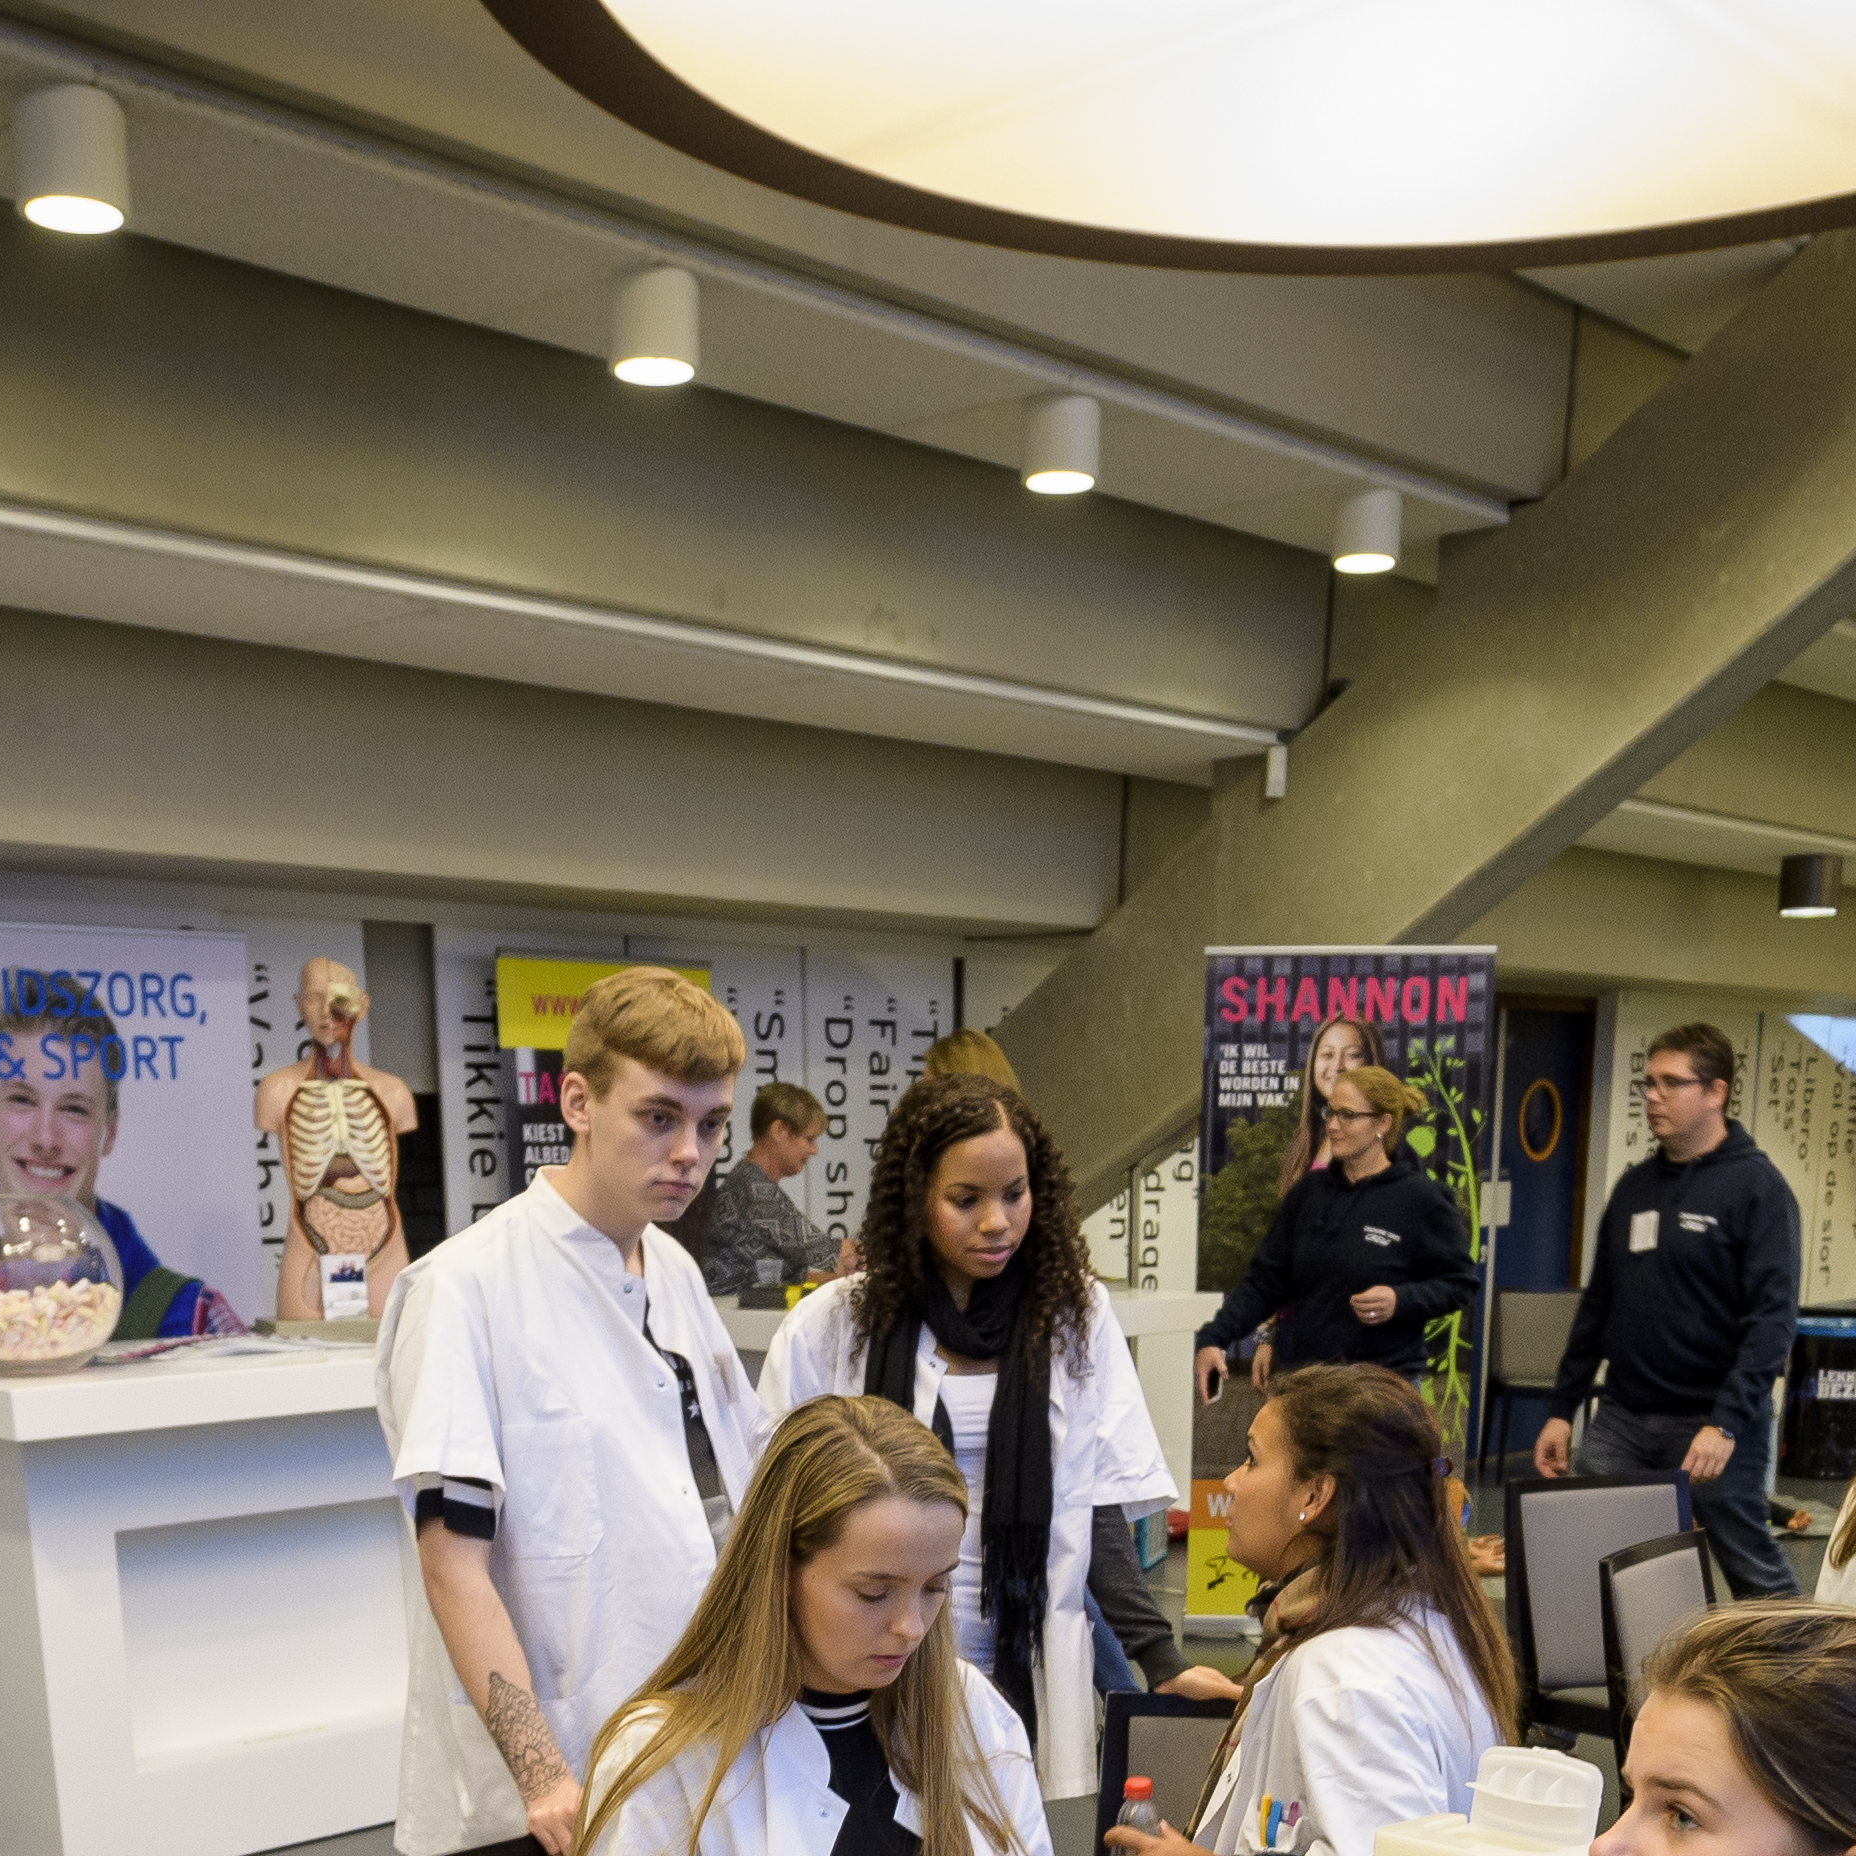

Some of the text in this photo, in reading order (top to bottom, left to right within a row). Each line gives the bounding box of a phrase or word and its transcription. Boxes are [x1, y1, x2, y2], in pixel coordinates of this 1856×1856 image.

[1220, 976, 1468, 1023] SHANNON
[41, 1034, 184, 1082] SPORT
[867, 997, 898, 1116] “Fair
[1243, 1044, 1270, 1060] WIL
[825, 995, 855, 1139] “Drop
[1219, 1059, 1287, 1075] DE BESTE
[1218, 1076, 1299, 1092] WORDEN IN
[1218, 1092, 1253, 1108] MIJN
[522, 1123, 565, 1143] KIEST
[523, 1145, 573, 1164] ALBED
